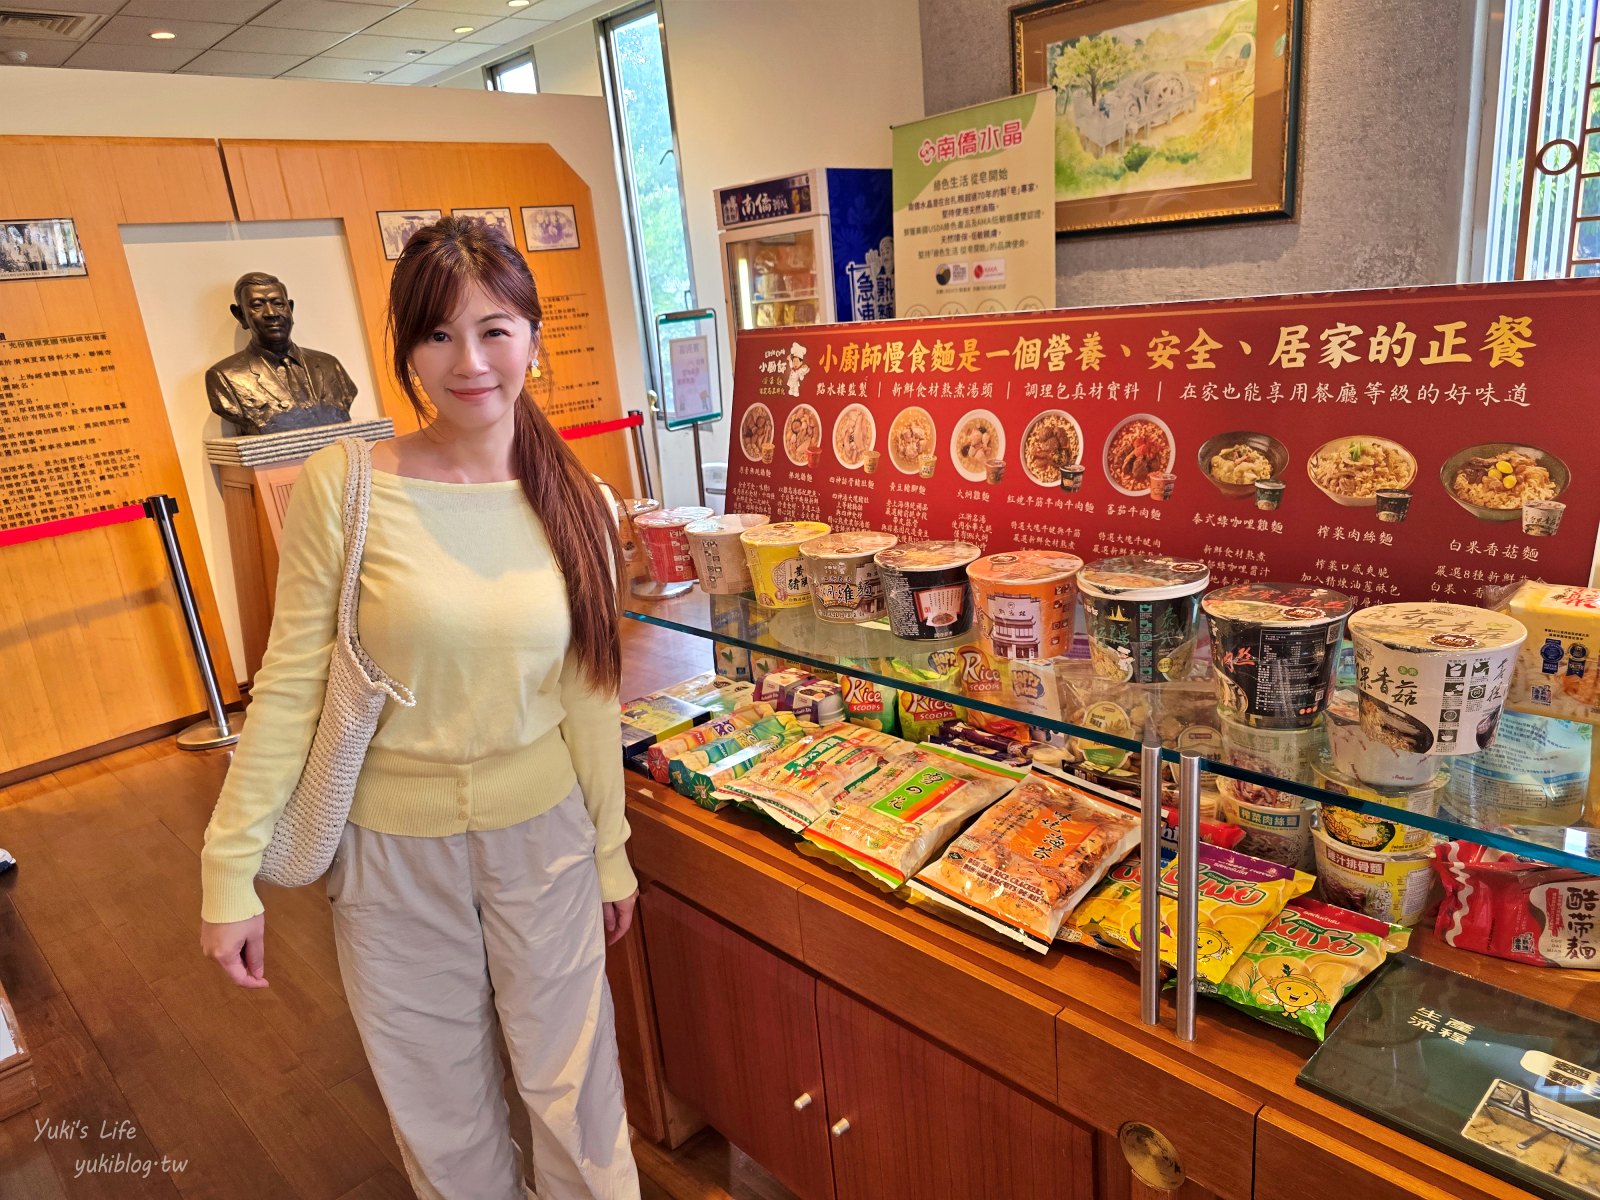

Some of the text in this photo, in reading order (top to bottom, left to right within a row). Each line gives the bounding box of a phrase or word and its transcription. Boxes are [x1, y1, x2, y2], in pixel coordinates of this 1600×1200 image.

[936, 121, 1022, 161] 南僑水晶
[818, 314, 1537, 375] 小廚師慢食麵是一個營養、安全、居家的正餐
[815, 380, 1532, 408] 點水樓監製 新鮮食材熬煮湯頭 調理包真材實料 在家也能享用餐廳等級的好味道
[1106, 503, 1161, 521] 蕃茄牛肉麵
[1317, 524, 1394, 547] 榨菜肉絲麵
[1449, 539, 1540, 563] 白果香菇麵
[961, 653, 1000, 681] Rice
[843, 675, 881, 703] Rice
[920, 711, 954, 720] SCOOPS
[1407, 1015, 1470, 1046] 流程
[1415, 1006, 1476, 1035] 生產
